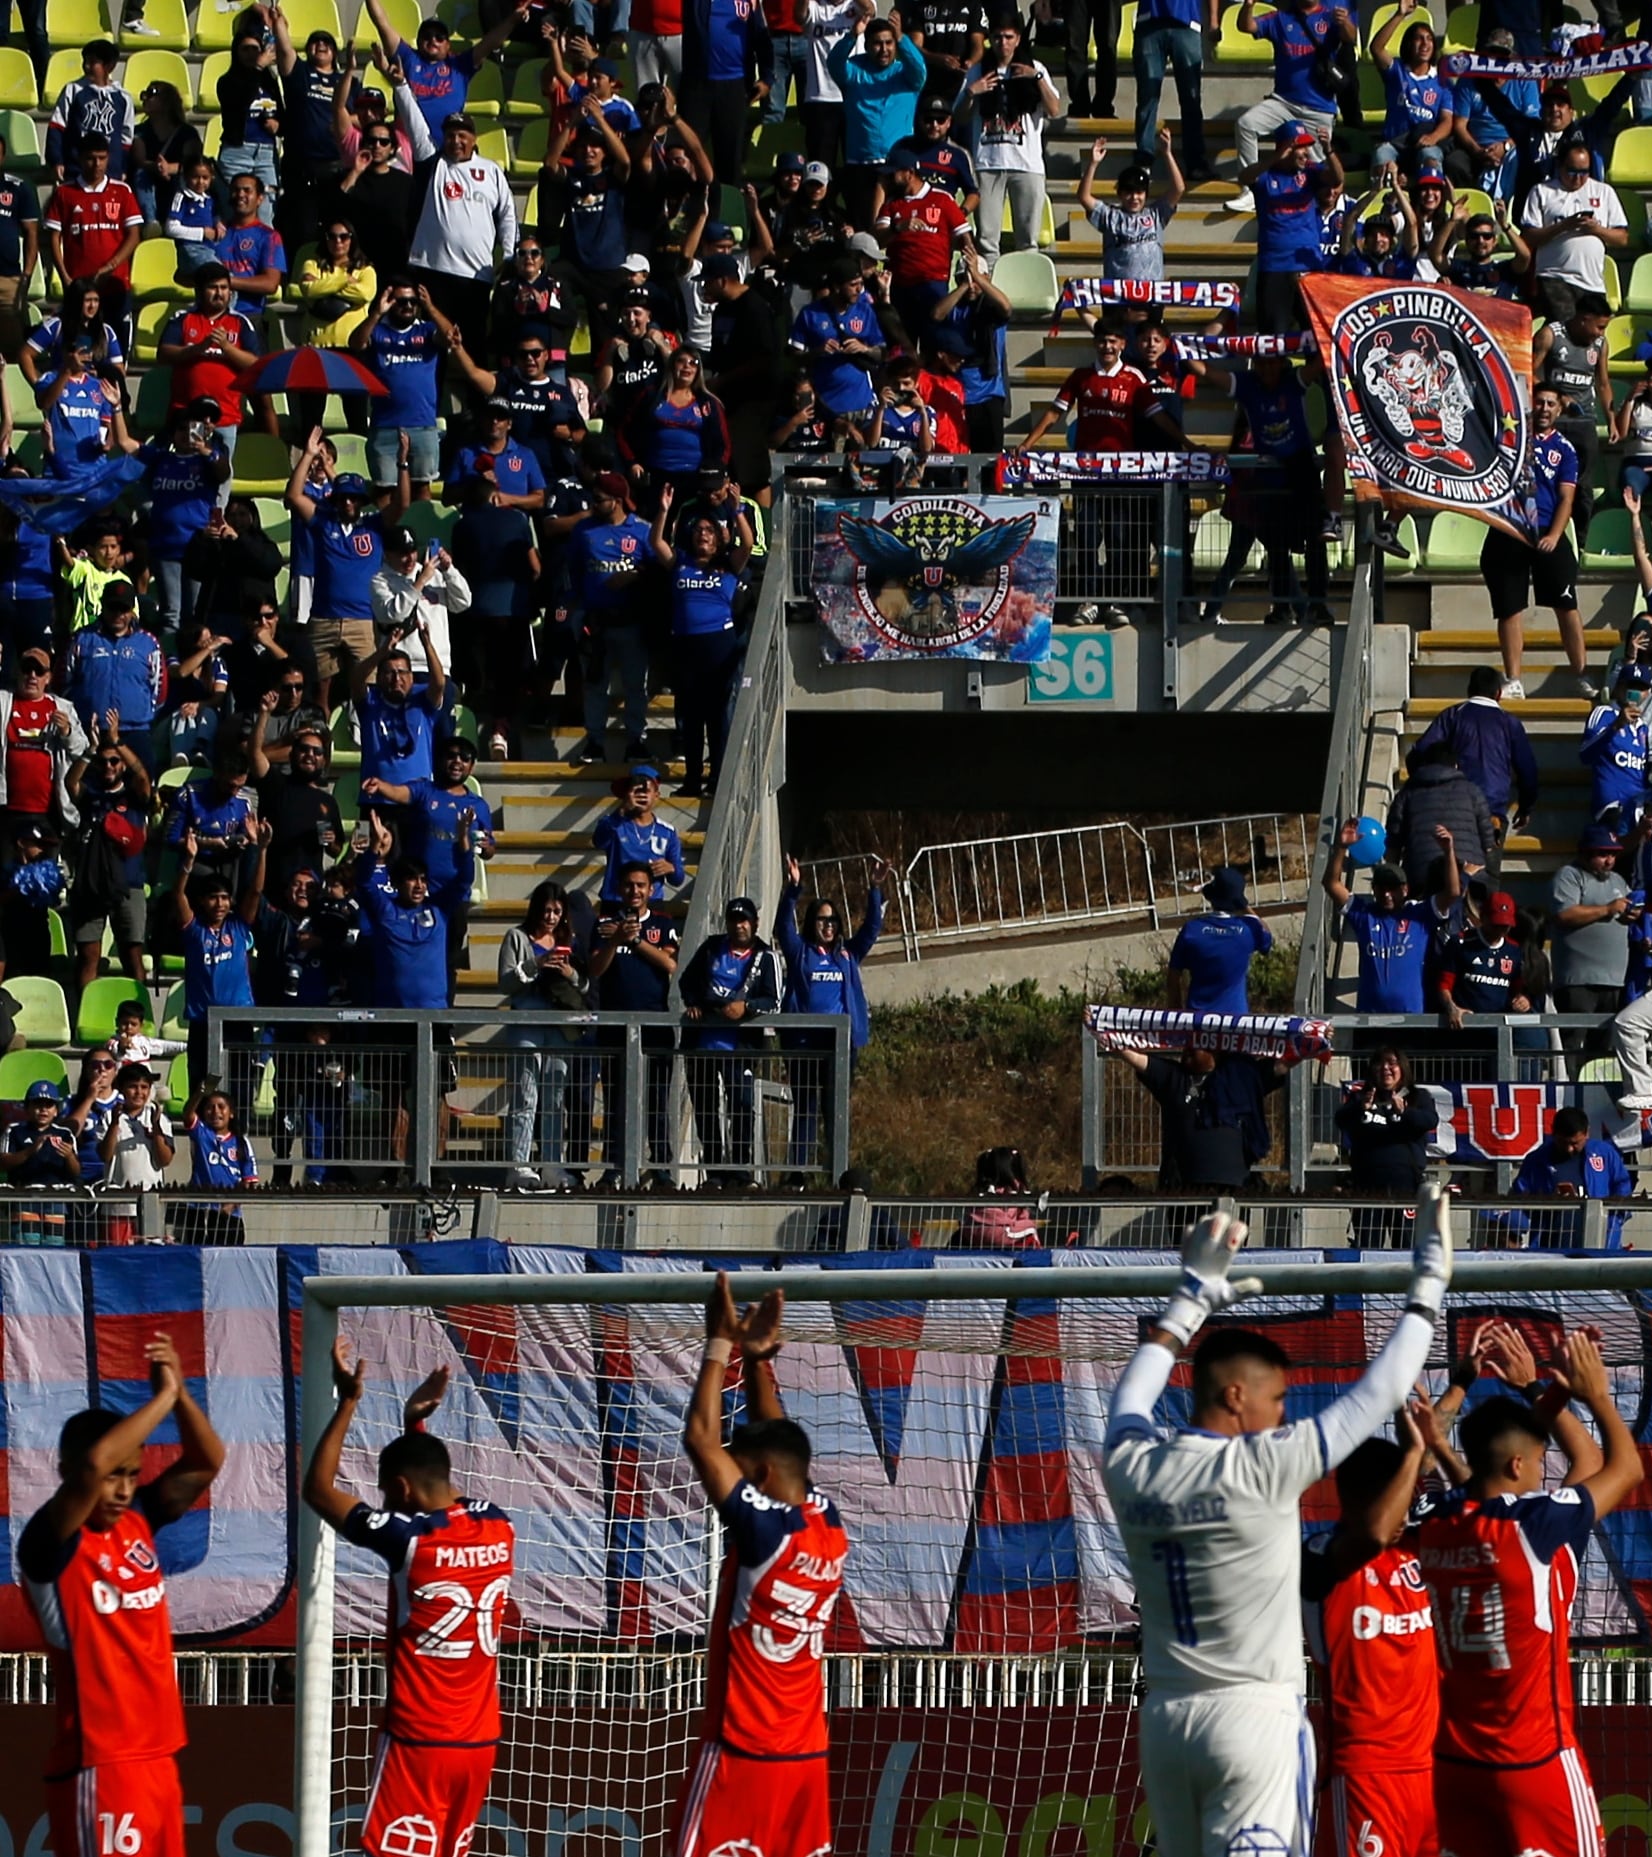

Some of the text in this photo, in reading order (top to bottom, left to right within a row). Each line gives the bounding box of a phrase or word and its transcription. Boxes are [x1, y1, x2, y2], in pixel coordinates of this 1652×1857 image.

[1573, 41, 1651, 74] LLAY
[1071, 280, 1237, 307] HIJUELAS
[1344, 304, 1376, 341] LOS
[1175, 334, 1317, 361] HIJUELA
[1027, 451, 1212, 474] MATENES
[1362, 440, 1402, 477] AMOR
[1405, 467, 1437, 490] QUE
[1440, 476, 1485, 501] NUNKA
[891, 498, 986, 529] CORDILLERA
[353, 534, 373, 557] U
[676, 574, 722, 590] Claro
[884, 625, 899, 640] ME
[958, 628, 972, 642] DE
[1033, 640, 1106, 697] S6
[651, 835, 667, 856] U
[1085, 1004, 1195, 1034] FAMILIA
[1192, 1032, 1218, 1050] LOS
[1221, 1034, 1239, 1053] DE
[1242, 1035, 1286, 1060] ABAJO
[1122, 1496, 1229, 1527] AMPOS VELIZ
[125, 1539, 158, 1573] U
[435, 1542, 511, 1570] MATEOS
[1420, 1545, 1479, 1570] ORALES
[1399, 1556, 1428, 1593] U
[98, 1811, 142, 1856] 16
[1356, 1818, 1384, 1857] 6
